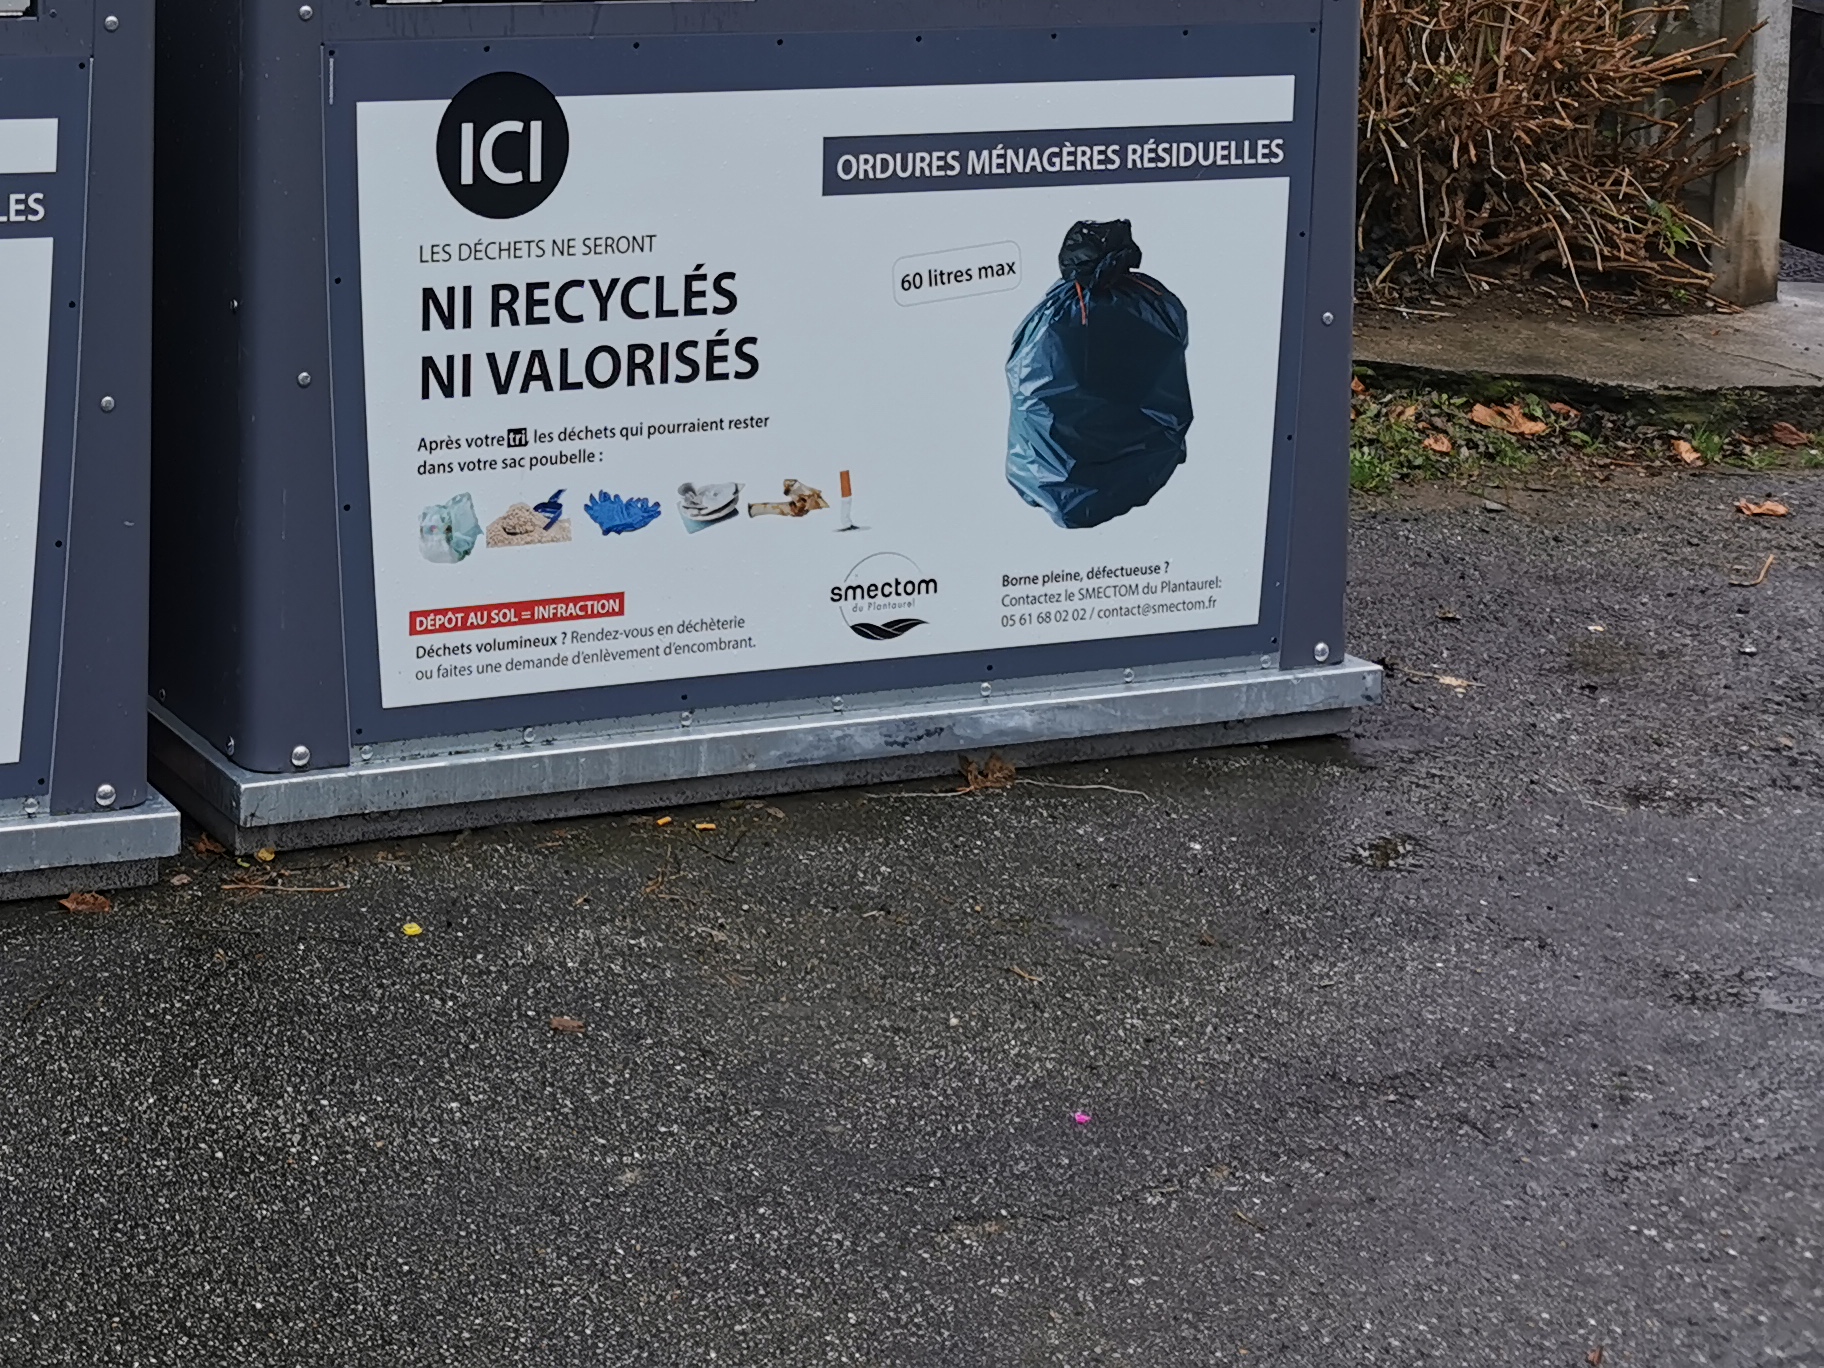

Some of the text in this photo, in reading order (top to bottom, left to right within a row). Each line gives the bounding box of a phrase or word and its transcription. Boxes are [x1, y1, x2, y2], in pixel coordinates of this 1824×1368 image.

[460, 119, 543, 185] ICI
[836, 138, 1285, 181] ORDURES MÉNAGÈRES RÉSIDUELLES
[419, 234, 658, 264] LES DÉCHETS NE SERONT
[900, 261, 1017, 292] 60 litres max
[421, 263, 738, 332] NI RECYCLÉS
[421, 327, 760, 401] NI VALORISÉS
[417, 435, 462, 455] Après
[465, 435, 505, 450] votre
[533, 429, 555, 444] les
[557, 425, 617, 443] déchets
[619, 421, 643, 441] qui
[647, 417, 725, 440] pourraient
[728, 415, 770, 430] rester
[417, 448, 603, 476] dans votre sac poubelle :
[829, 577, 938, 603] smectom
[1001, 560, 1170, 588] Borne pleine, défectueuse ?
[851, 597, 916, 613] du Plantaurel
[1001, 575, 1223, 608] Contactez le SMECTOM du Plantaurel:
[415, 598, 620, 632] DÉPÔT AU SOL = INFRACTION
[1000, 595, 1217, 628] 05 61 68 02 02 / contact@smectom.fr
[415, 615, 746, 660] Déchets volumineux ? Rendez-vous en déchèterie
[415, 636, 757, 681] ou faites une demande d'enlèvement d'encombrant.
